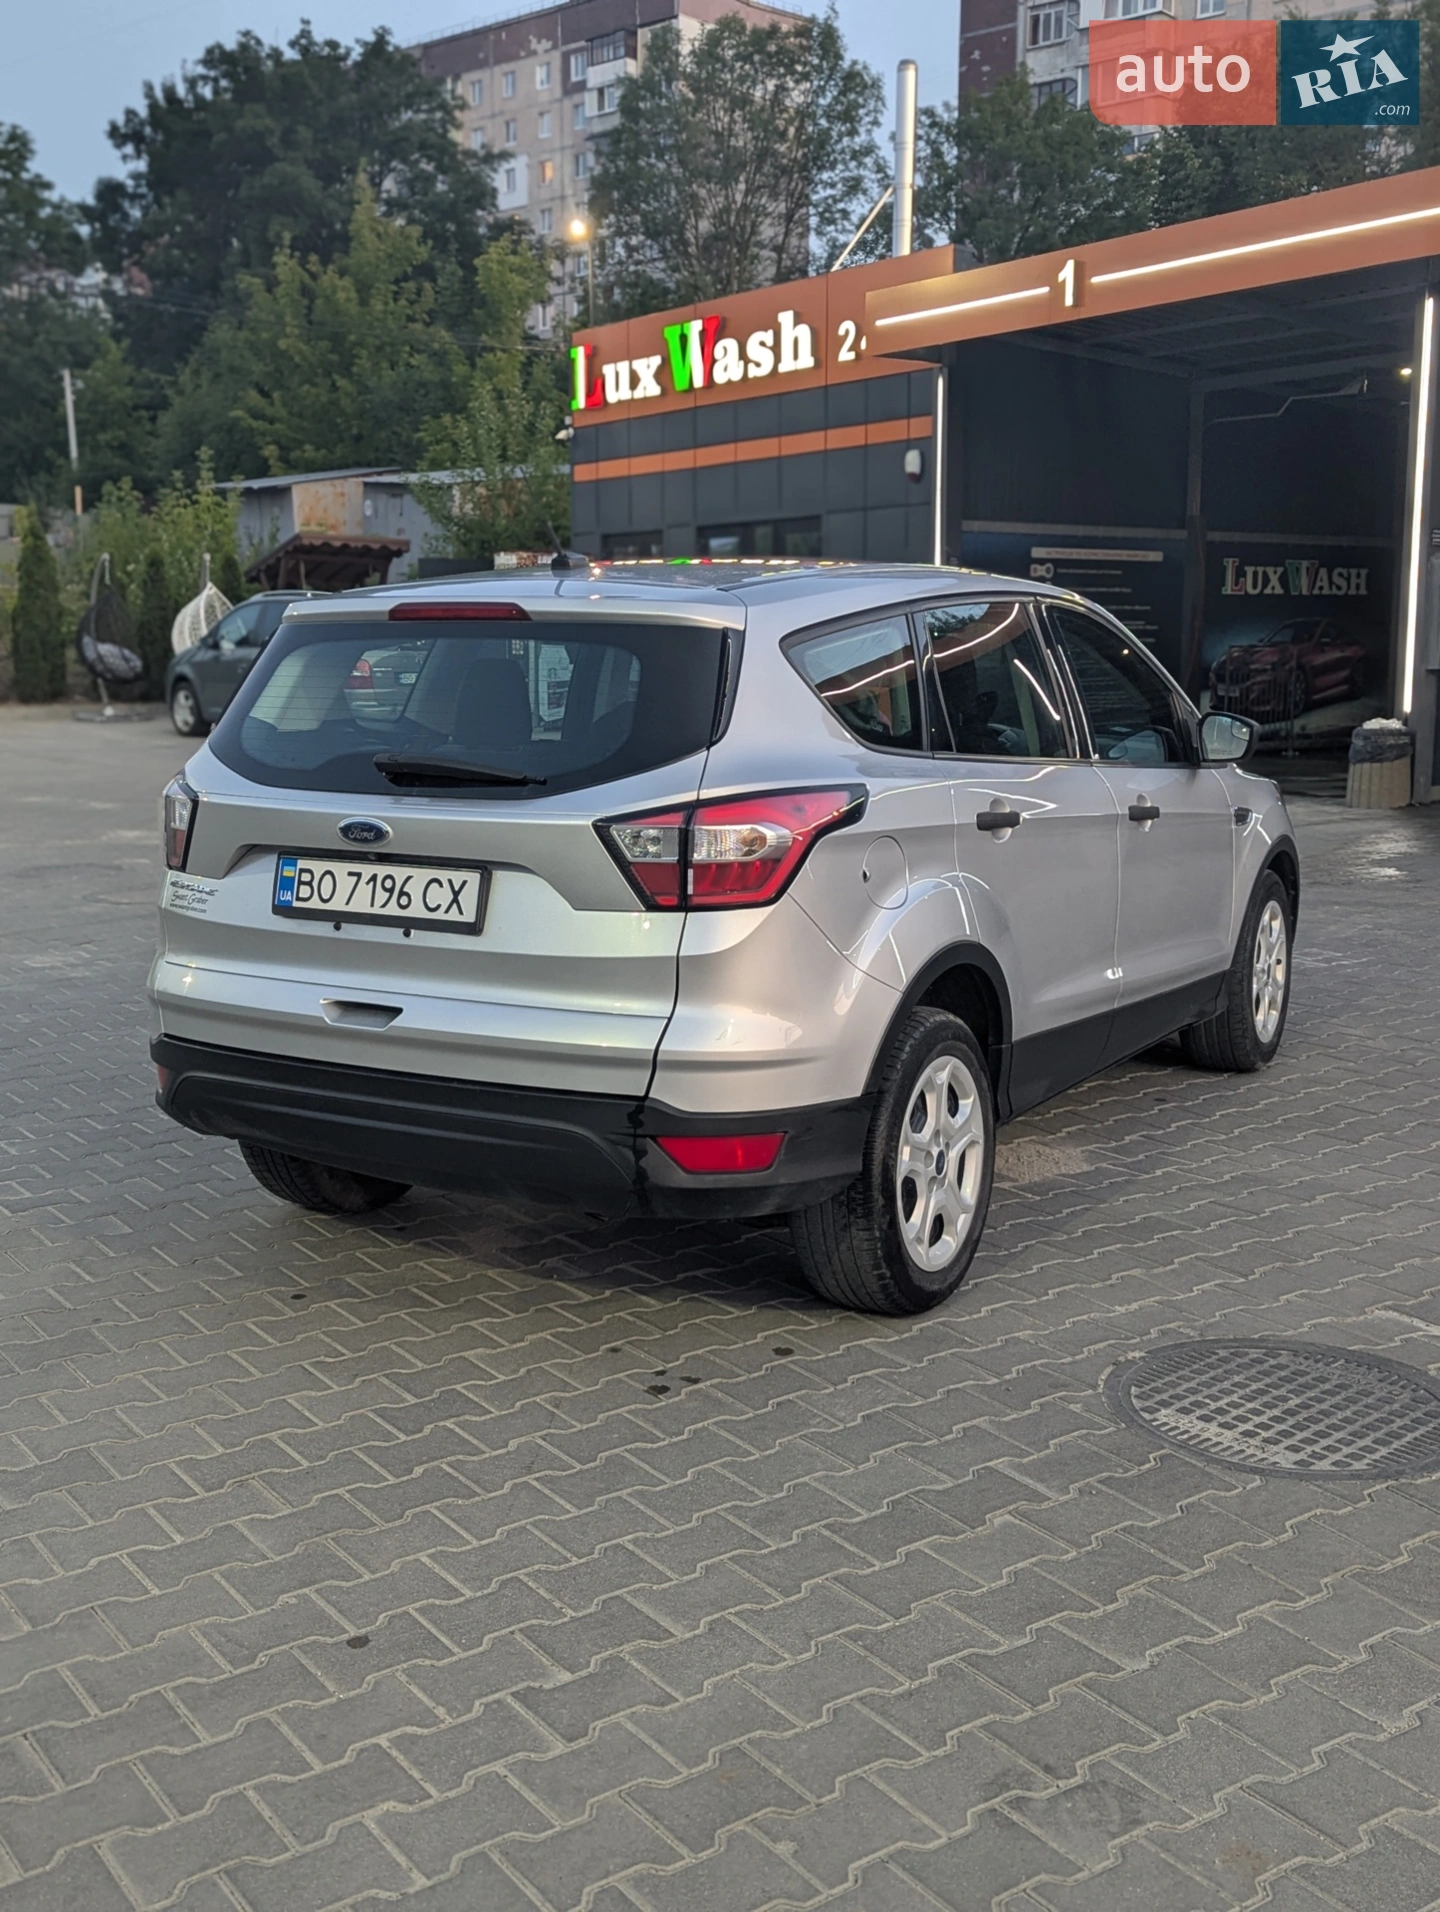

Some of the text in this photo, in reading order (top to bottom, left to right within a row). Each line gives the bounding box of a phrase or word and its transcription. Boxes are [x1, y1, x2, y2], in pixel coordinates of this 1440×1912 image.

[1057, 259, 1076, 307] 1
[837, 319, 867, 362] 2
[348, 824, 376, 840] Ford
[280, 890, 292, 901] UA
[295, 867, 468, 916] BO 7196 CX
